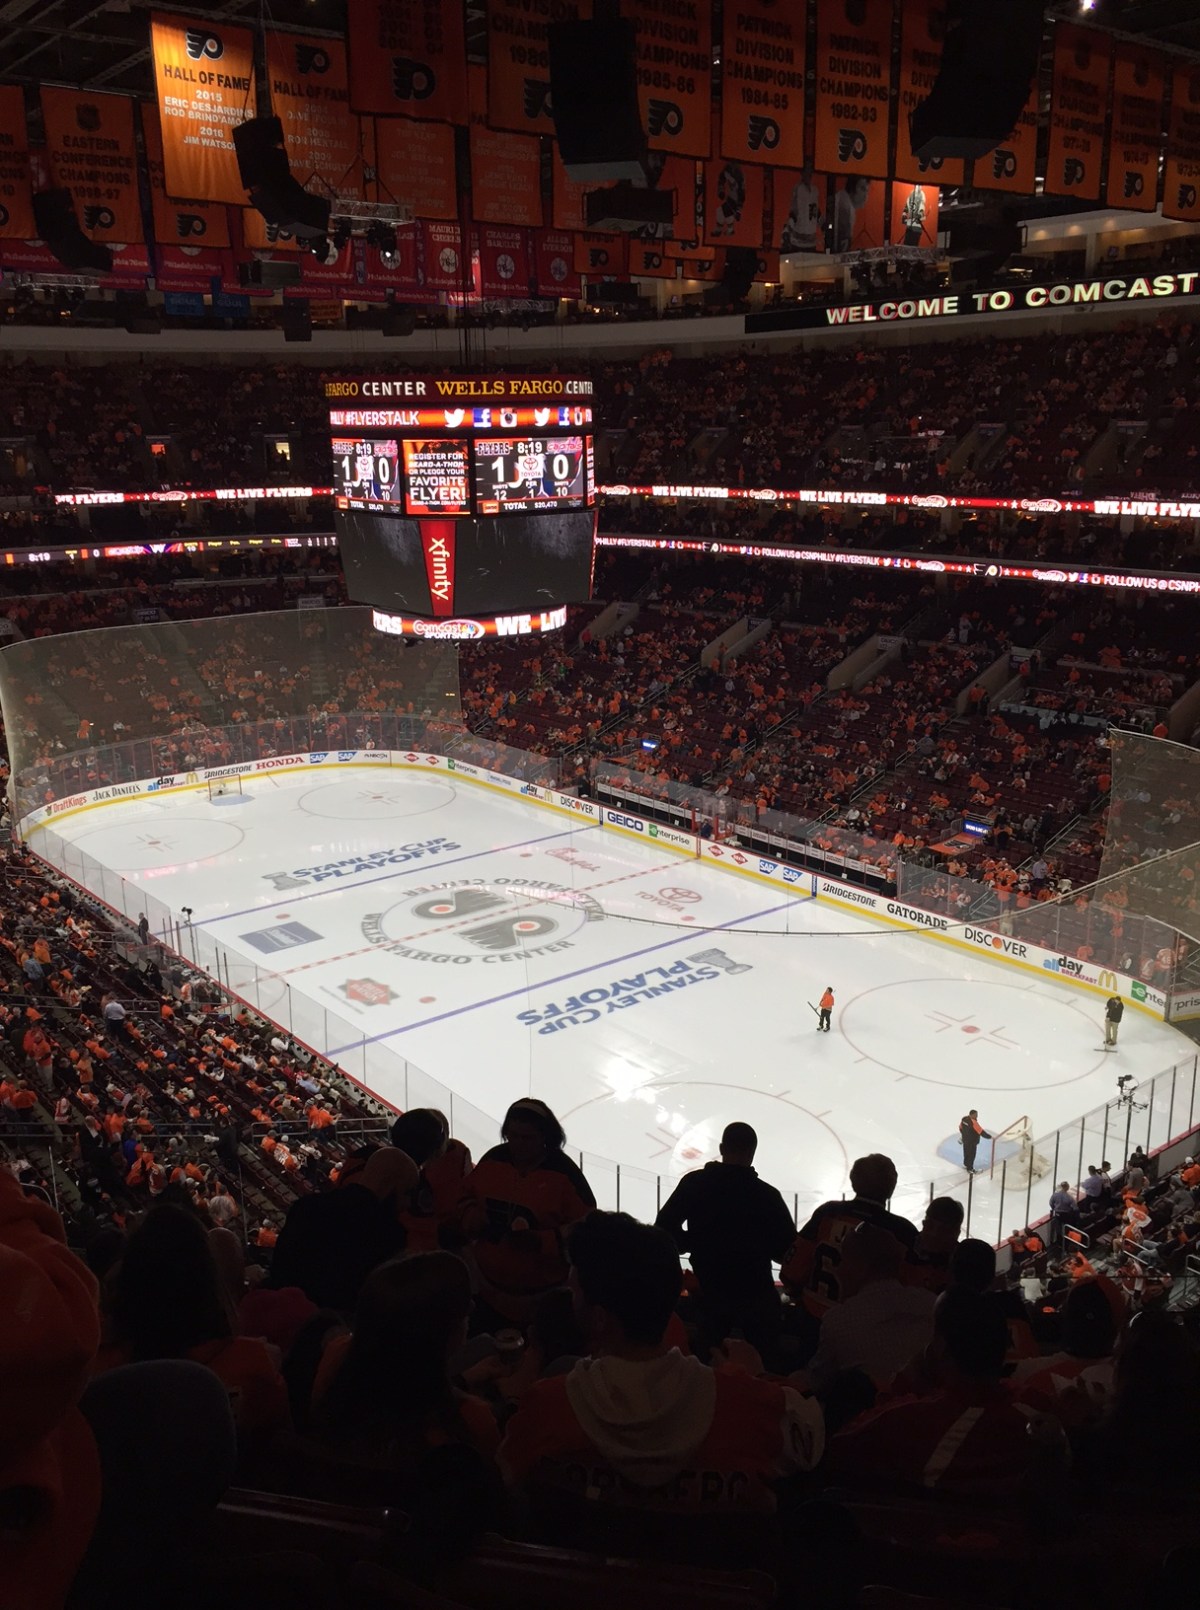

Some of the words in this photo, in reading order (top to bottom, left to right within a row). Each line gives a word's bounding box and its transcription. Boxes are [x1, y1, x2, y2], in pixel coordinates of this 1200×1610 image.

[735, 38, 794, 64] DIVISION
[727, 59, 803, 89] CHAMPIONS
[829, 56, 881, 79] DIVISION
[164, 64, 196, 83] HALL
[198, 70, 214, 86] OF
[217, 74, 250, 92] FAME
[196, 90, 223, 103] 2015
[273, 80, 304, 98] HALL
[820, 77, 888, 101] CHAMPIONS
[164, 95, 189, 110] ERIC
[191, 102, 254, 118] DESJARDINS
[741, 88, 788, 110] 1984-85
[164, 107, 187, 120] ROD
[831, 102, 877, 122] 1982-83
[183, 136, 200, 147] JIM
[199, 126, 224, 140] 2016
[827, 296, 959, 324] WELCOME
[973, 290, 1013, 312] TO
[1026, 276, 1200, 308] COMCAST
[363, 382, 427, 397] CENTER
[436, 381, 505, 399] WELLS
[510, 381, 563, 397] FARGO
[517, 442, 543, 455] 8:19
[342, 456, 351, 481] 1
[379, 457, 390, 483] 0
[492, 457, 505, 483] 1
[553, 454, 569, 480] 0
[410, 476, 465, 486] FAVORITE
[75, 493, 124, 504] FLYERS
[215, 489, 236, 499] WE
[237, 489, 264, 499] LIVE
[266, 487, 312, 498] FLYERS
[410, 487, 466, 501] FLYER!
[494, 490, 508, 501] 12
[556, 487, 569, 498] 10
[652, 486, 669, 497] WE
[670, 486, 692, 497] LIVE
[694, 487, 728, 498] FLYERS
[800, 490, 816, 502] WE
[818, 491, 842, 503] LIVE
[844, 492, 886, 505] FLYERS
[503, 502, 529, 511] TOTAL
[1094, 500, 1120, 514] WE
[1121, 501, 1157, 516] LIVE
[428, 537, 453, 601] xfinity
[1104, 574, 1143, 588] FOLLOW
[413, 620, 463, 635] Comcast
[204, 764, 251, 779] BRIDGESTONE
[256, 756, 305, 771] HONDA
[147, 782, 160, 792] all
[157, 777, 174, 787] day
[53, 795, 87, 813] DraftKings
[92, 791, 111, 802] JACK
[560, 796, 594, 815] DISCOVER
[607, 811, 643, 832] GEICO
[650, 825, 690, 846] enterprise
[292, 848, 396, 878] STANLEY
[399, 837, 447, 852] CUP
[311, 842, 462, 882] PLAYOFFS
[760, 861, 775, 873] SAP
[783, 868, 799, 881] SAP
[634, 891, 685, 912] TOYOTA
[822, 882, 877, 908] BRIDGESTONE
[887, 903, 948, 931] GATORADE
[360, 912, 392, 945] WELLS
[381, 943, 472, 965] FARGO
[482, 940, 576, 964] CENTER
[964, 928, 1027, 958] DISCOVER
[1043, 958, 1060, 972] all
[1058, 956, 1084, 974] day
[516, 960, 694, 1027] PLAYOFFS
[606, 966, 721, 1014] STANLEY
[538, 1008, 601, 1036] CUP
